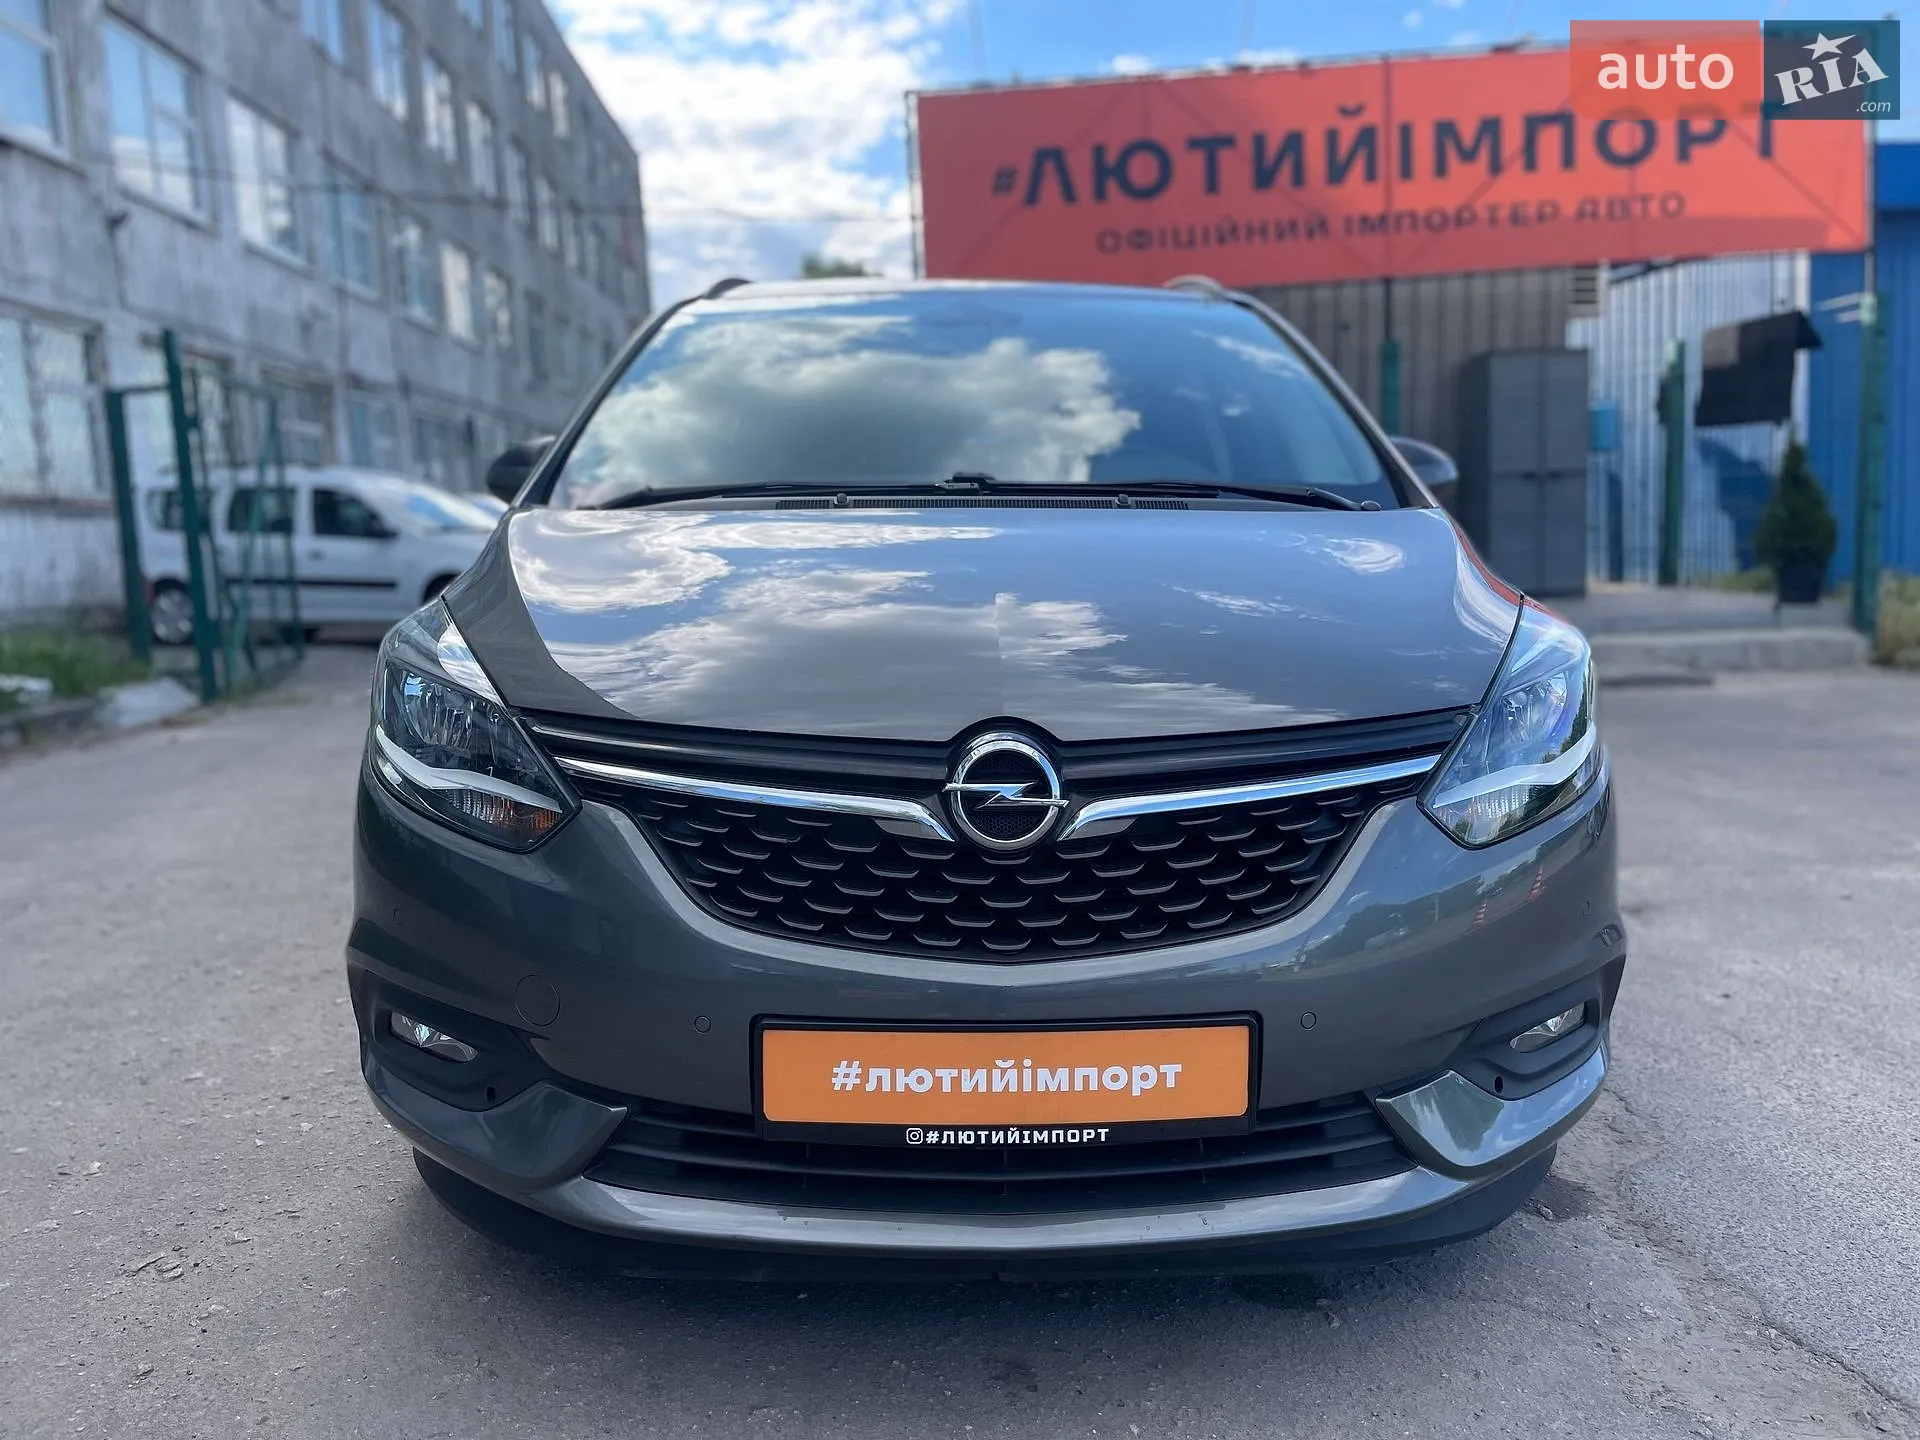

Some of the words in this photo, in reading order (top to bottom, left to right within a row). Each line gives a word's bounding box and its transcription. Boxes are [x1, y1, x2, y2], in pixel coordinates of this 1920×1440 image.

[1096, 214, 1330, 254] ОФІЦІЙНИЙ
[1343, 204, 1561, 239] ІМПОРТЕР
[1575, 191, 1687, 224] АВТО
[832, 1059, 1182, 1096] #лютийімпорт
[926, 1127, 1110, 1144] #ЛЮТИЙІМПОРТ
